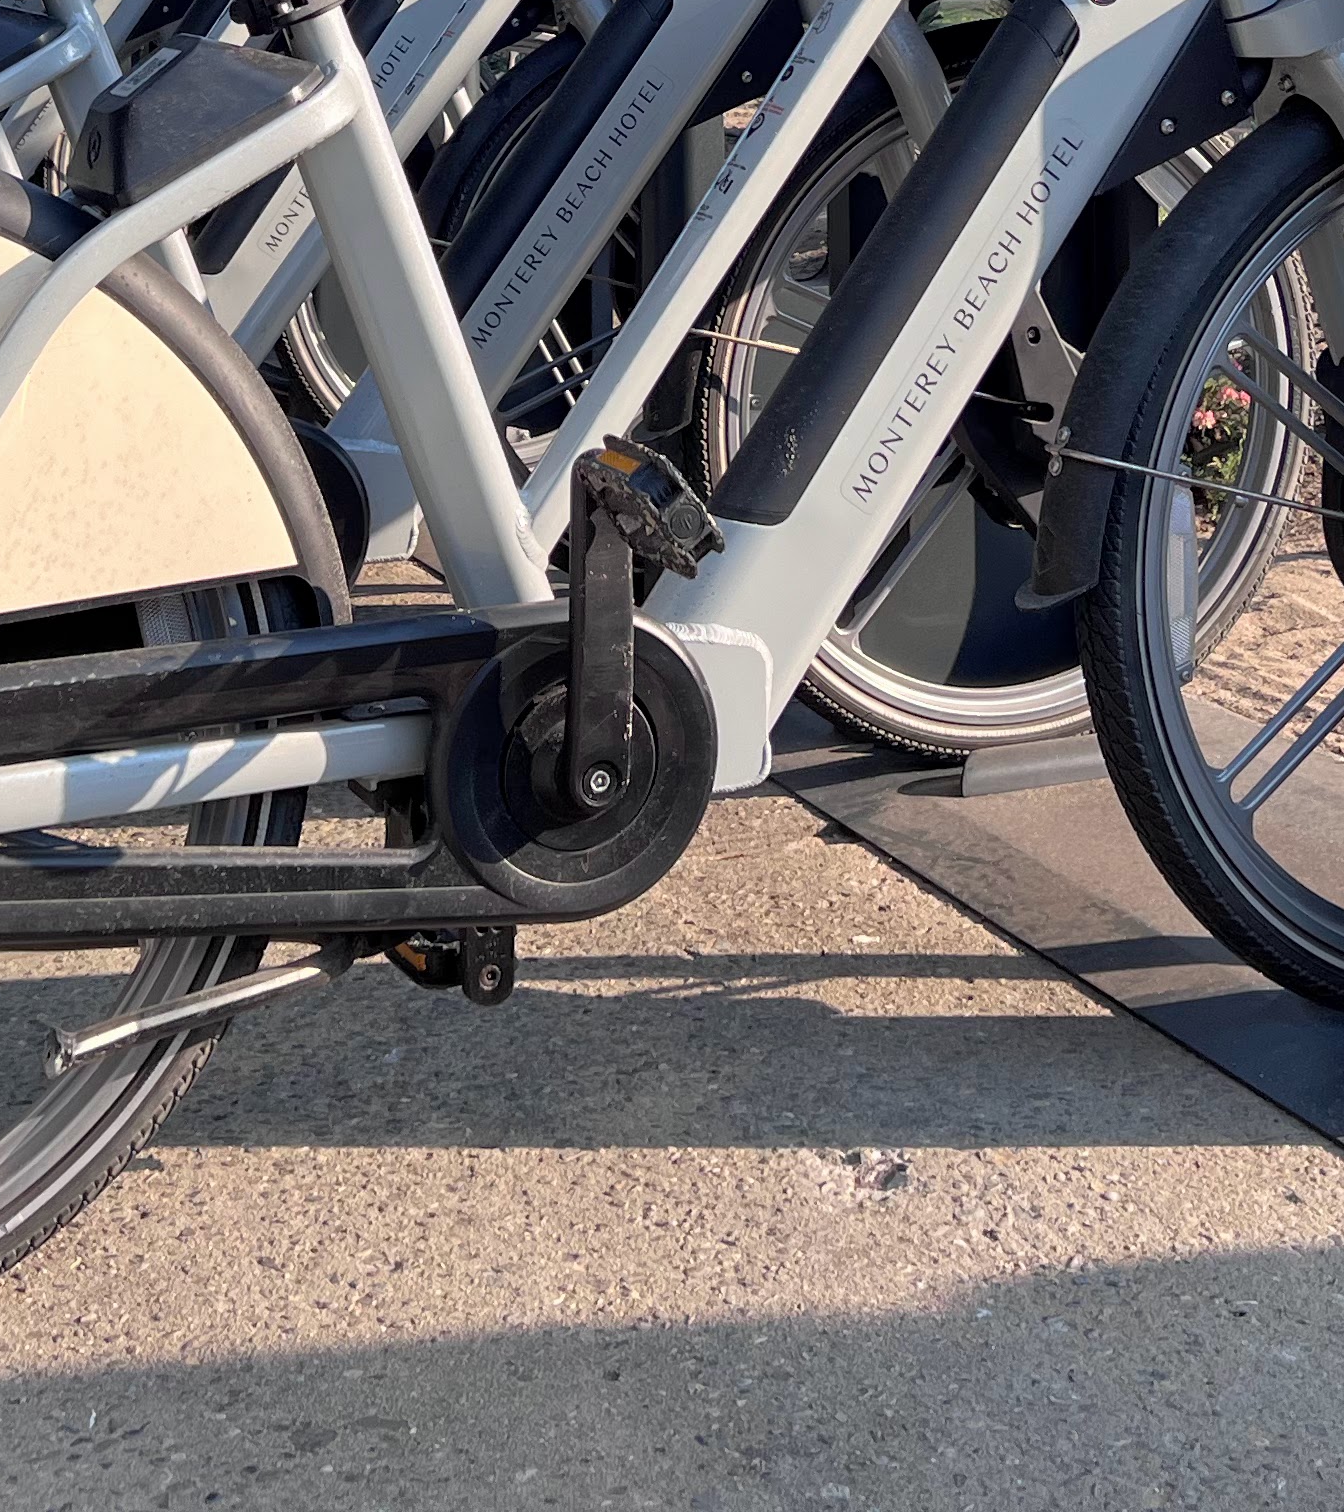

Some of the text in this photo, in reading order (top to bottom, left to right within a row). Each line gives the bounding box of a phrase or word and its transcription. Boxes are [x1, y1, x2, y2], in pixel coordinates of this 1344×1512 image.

[373, 33, 416, 90] HOTEL
[471, 77, 665, 350] MONTEREY BEACH HOTEL
[851, 134, 1085, 504] MONTEREY BEACH HOTEL
